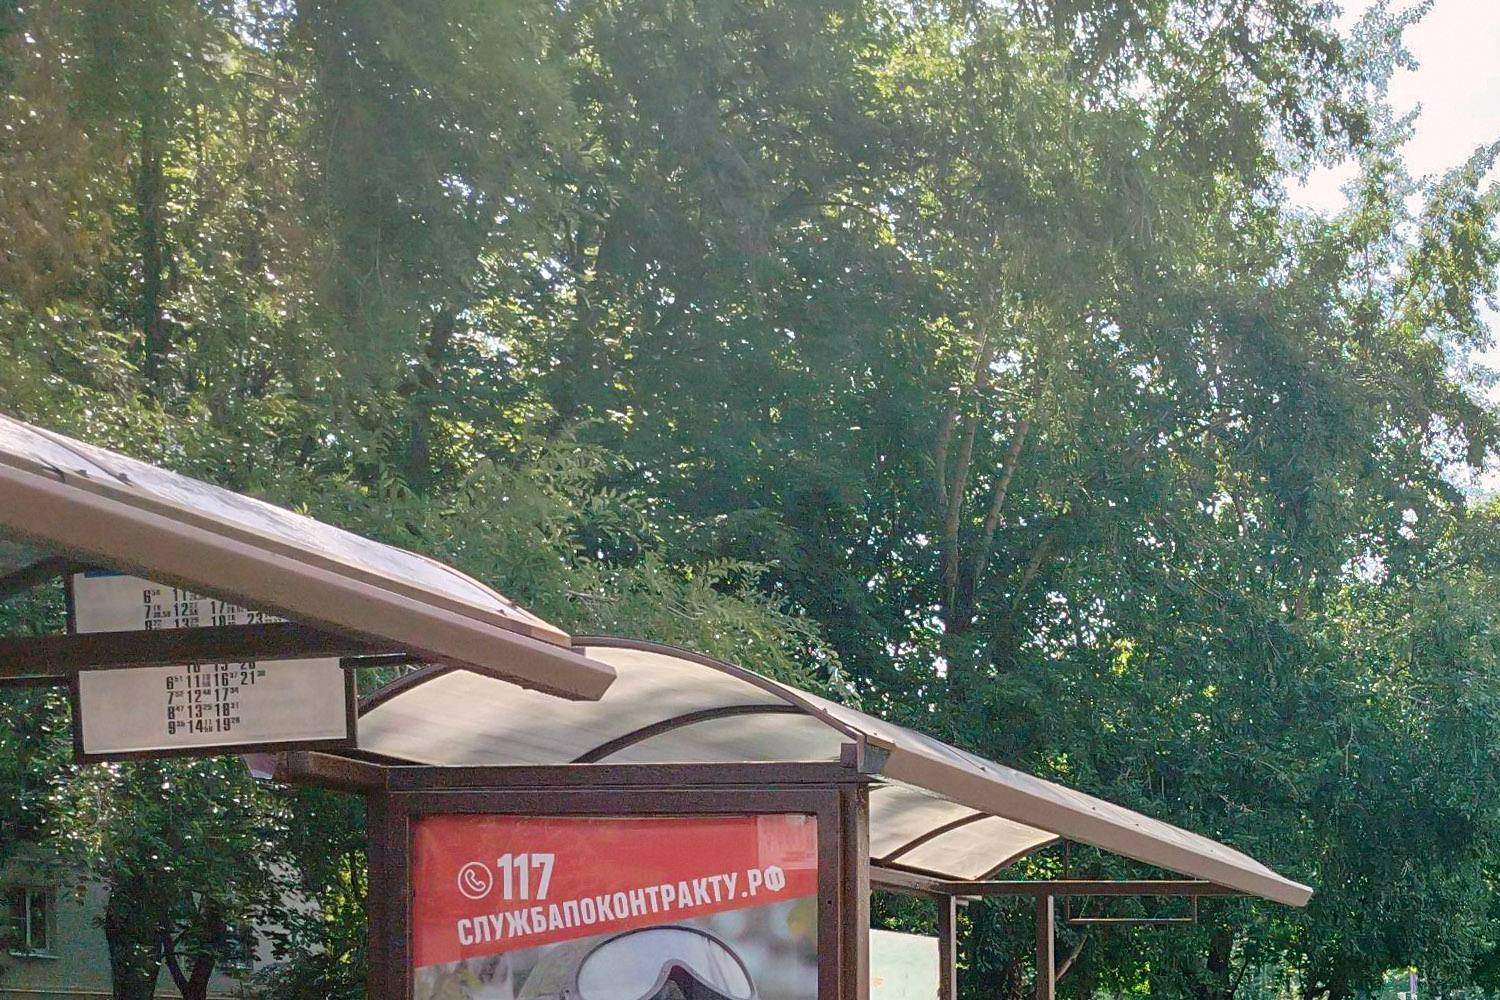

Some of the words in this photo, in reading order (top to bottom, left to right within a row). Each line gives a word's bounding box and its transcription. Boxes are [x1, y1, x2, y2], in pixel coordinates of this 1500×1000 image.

[215, 672, 229, 686] 16
[240, 671, 255, 685] 21
[215, 688, 229, 701] 17
[216, 718, 231, 732] 19
[497, 853, 555, 901] 117
[457, 865, 787, 946] СЛУЖБАПОКОНТРАКТУ.РФ
